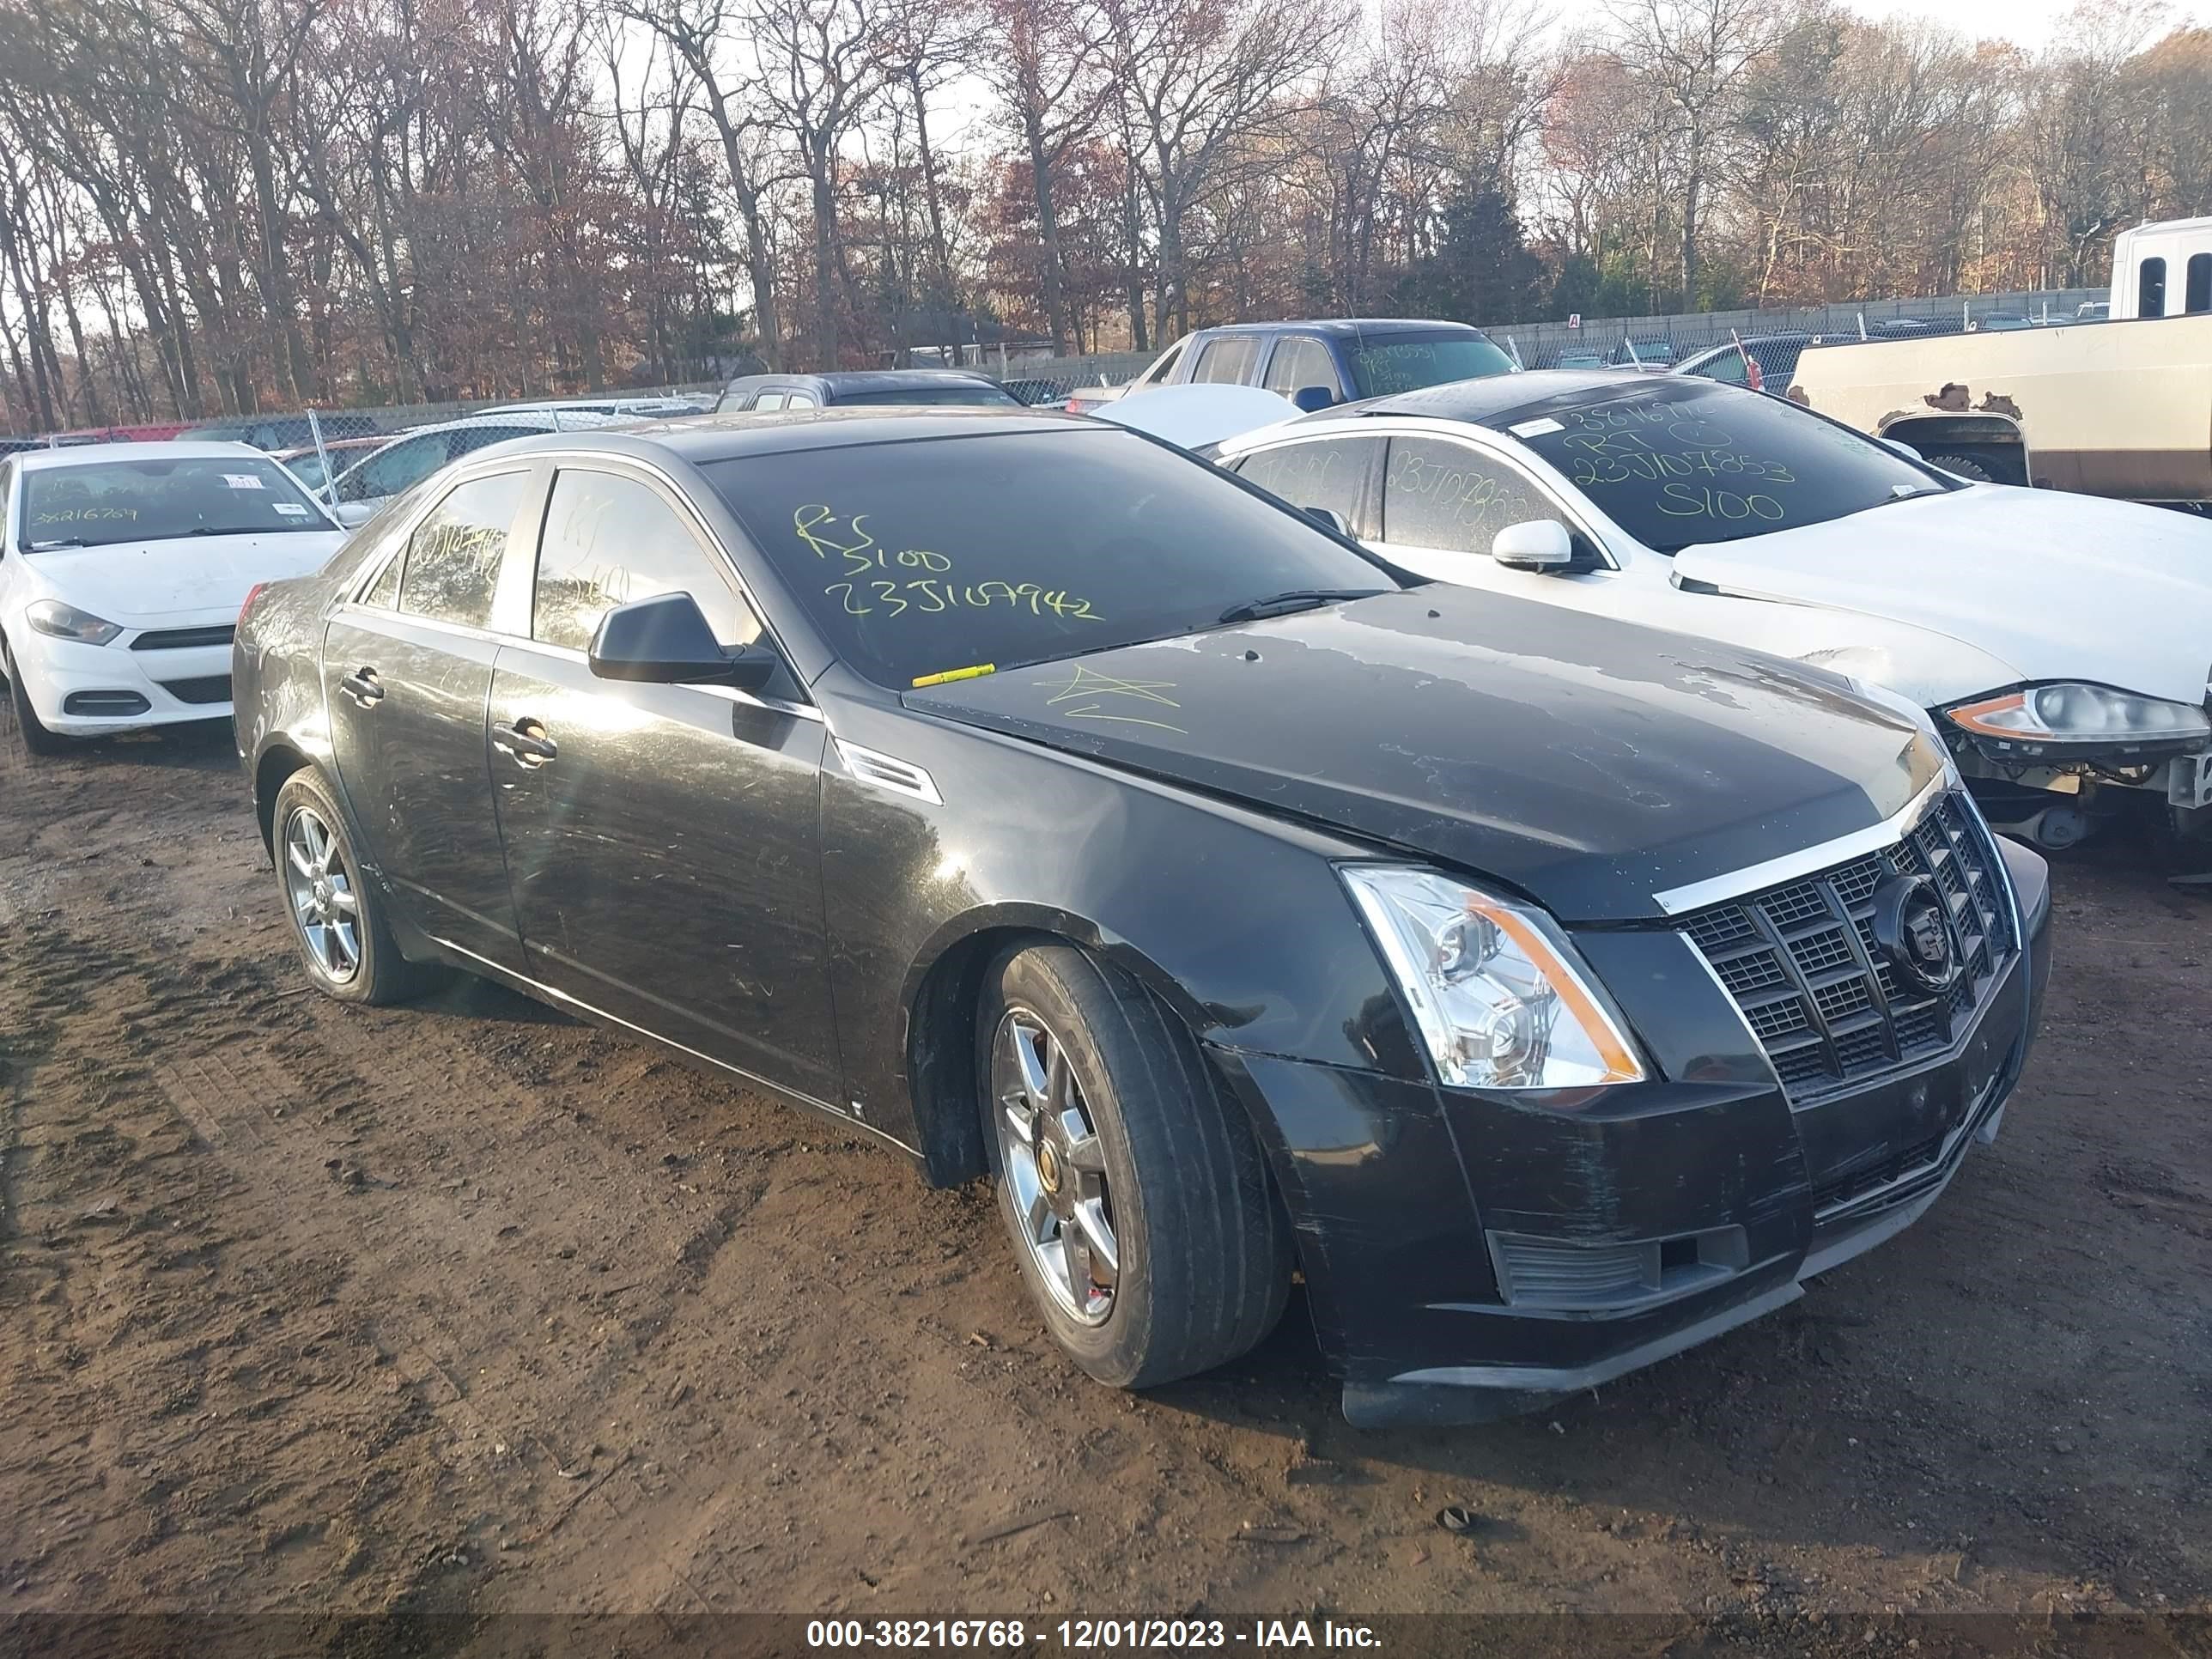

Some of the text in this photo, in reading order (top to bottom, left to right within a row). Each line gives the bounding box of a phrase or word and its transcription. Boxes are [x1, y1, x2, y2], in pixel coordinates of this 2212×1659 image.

[1570, 314, 1578, 326] A
[1564, 429, 1656, 455] RT
[1573, 449, 1796, 486] 23J107853
[1656, 483, 1784, 520] S100
